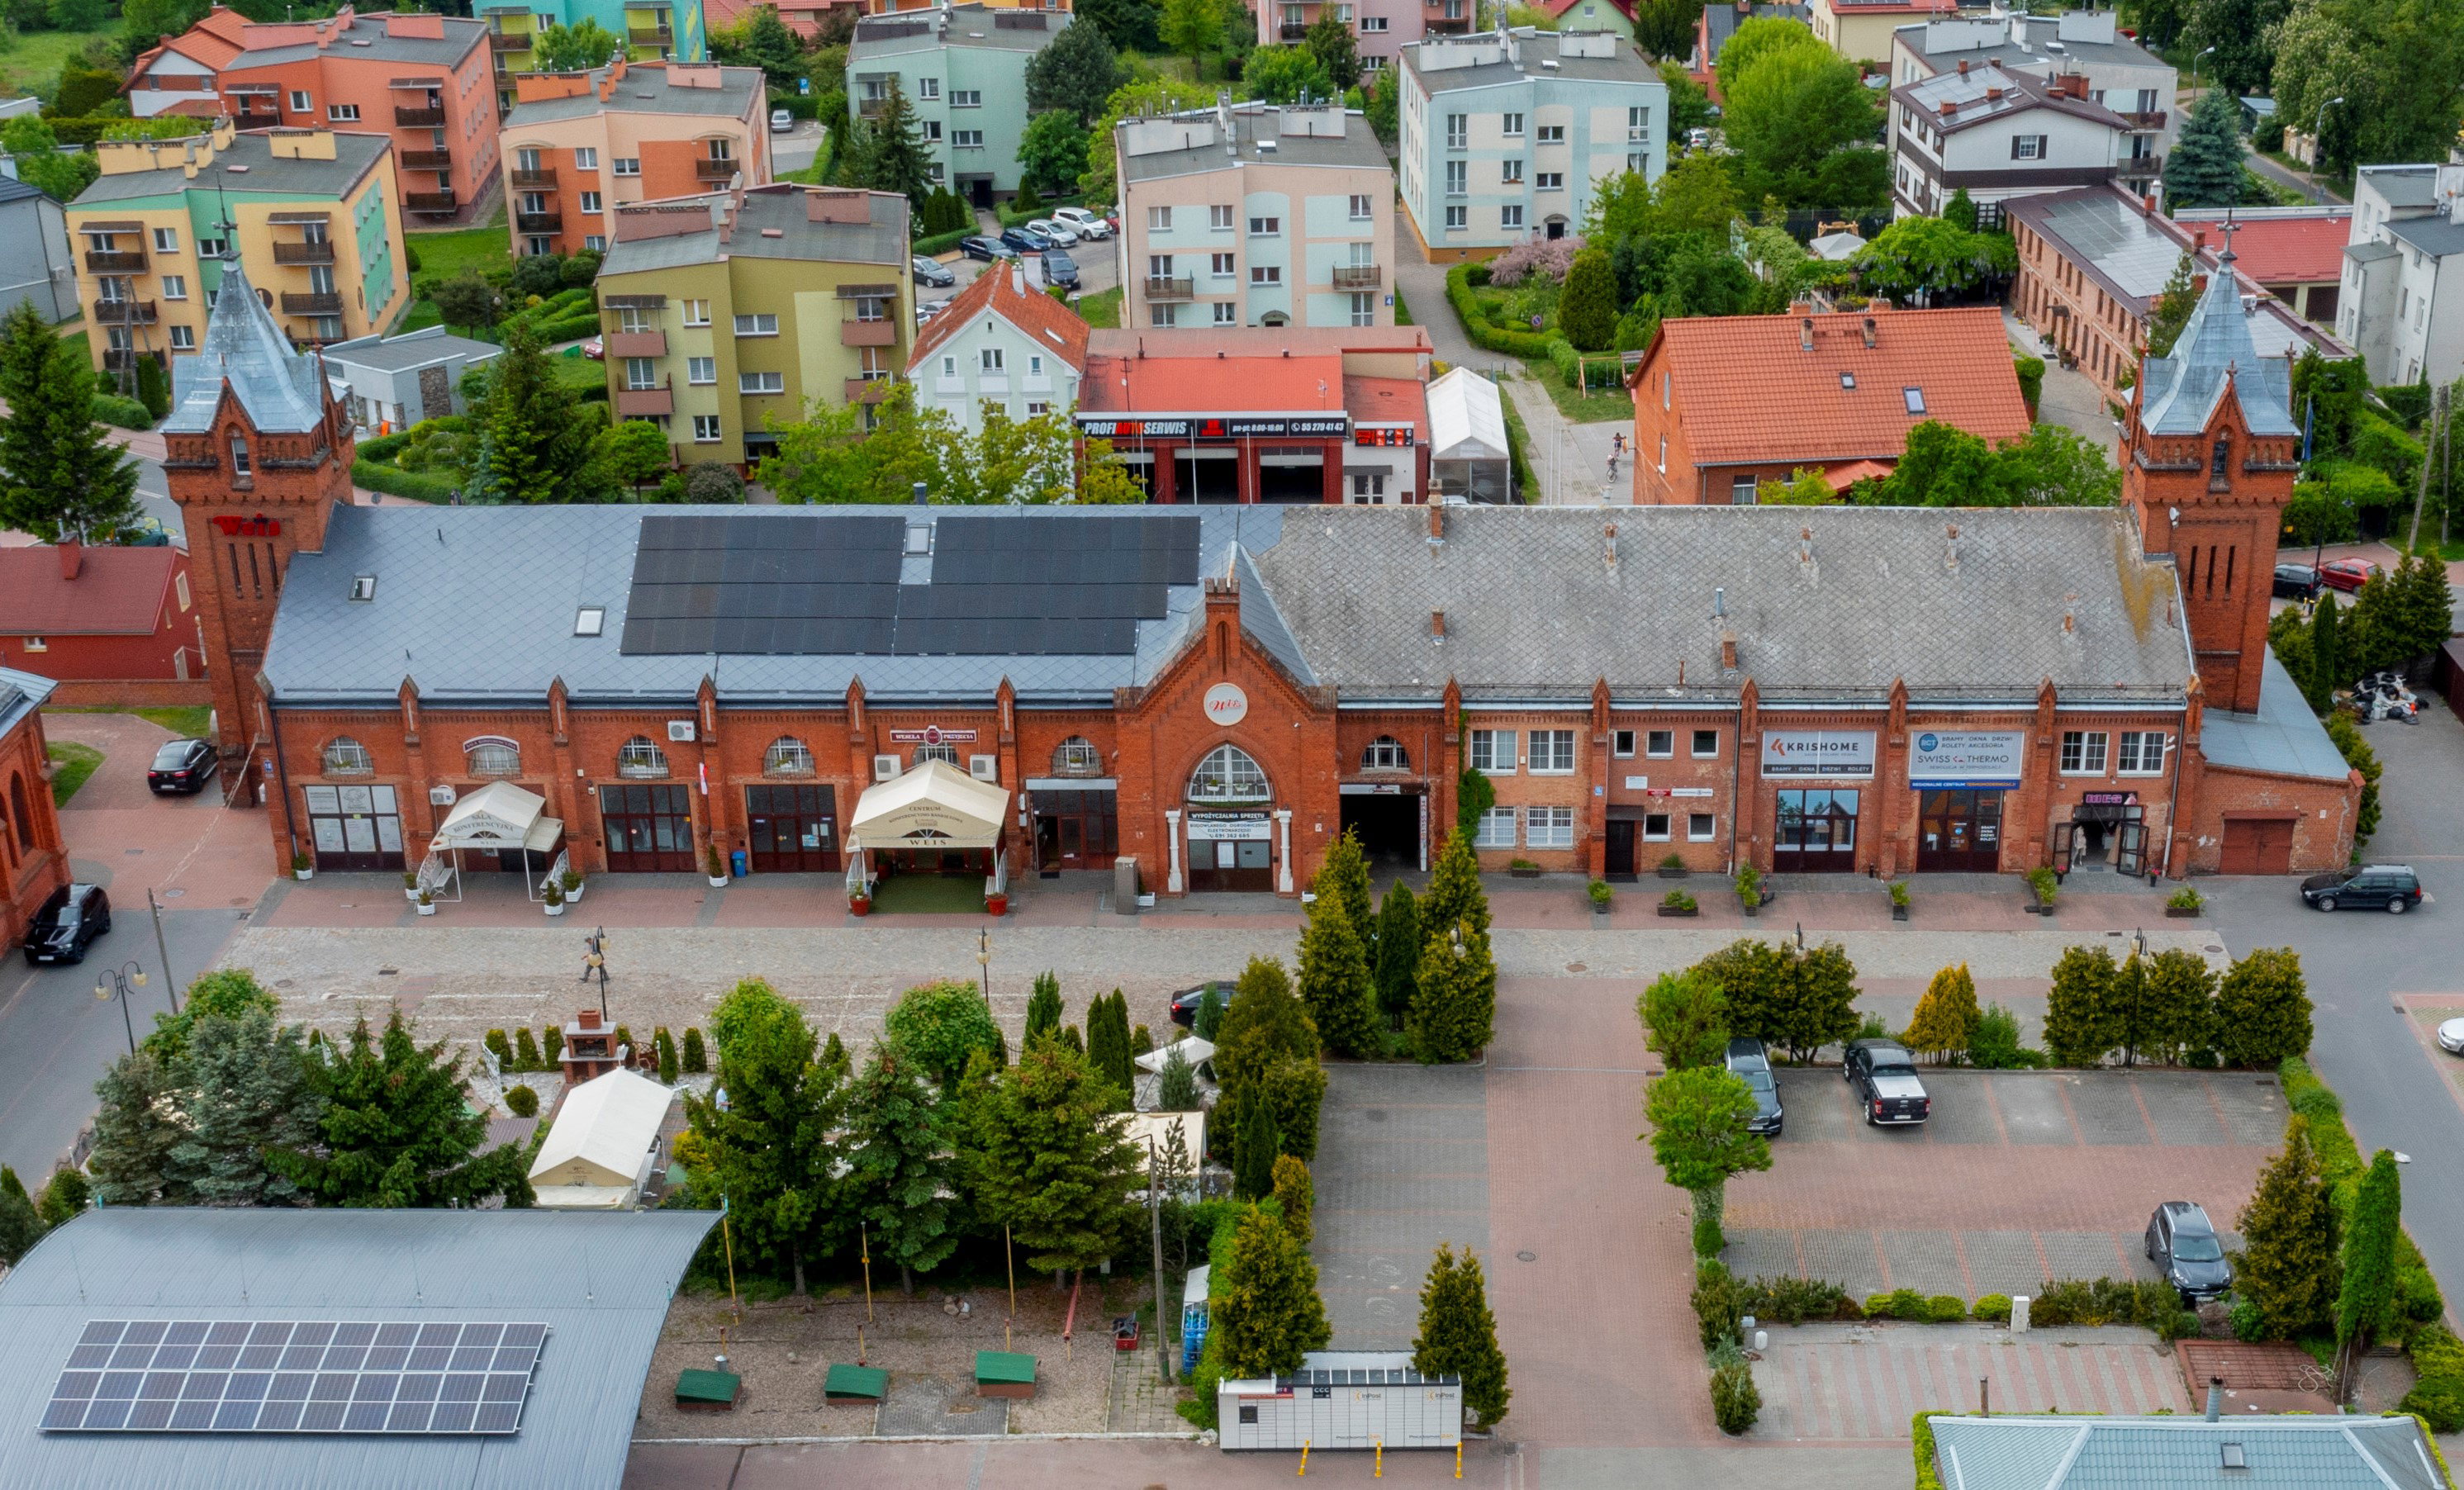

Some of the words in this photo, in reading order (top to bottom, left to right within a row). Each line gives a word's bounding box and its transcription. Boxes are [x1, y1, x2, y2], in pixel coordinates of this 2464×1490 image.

[1787, 743, 1859, 752] KRISHOME
[1917, 755, 1950, 763] SWISS
[1967, 755, 2009, 763] THERMO
